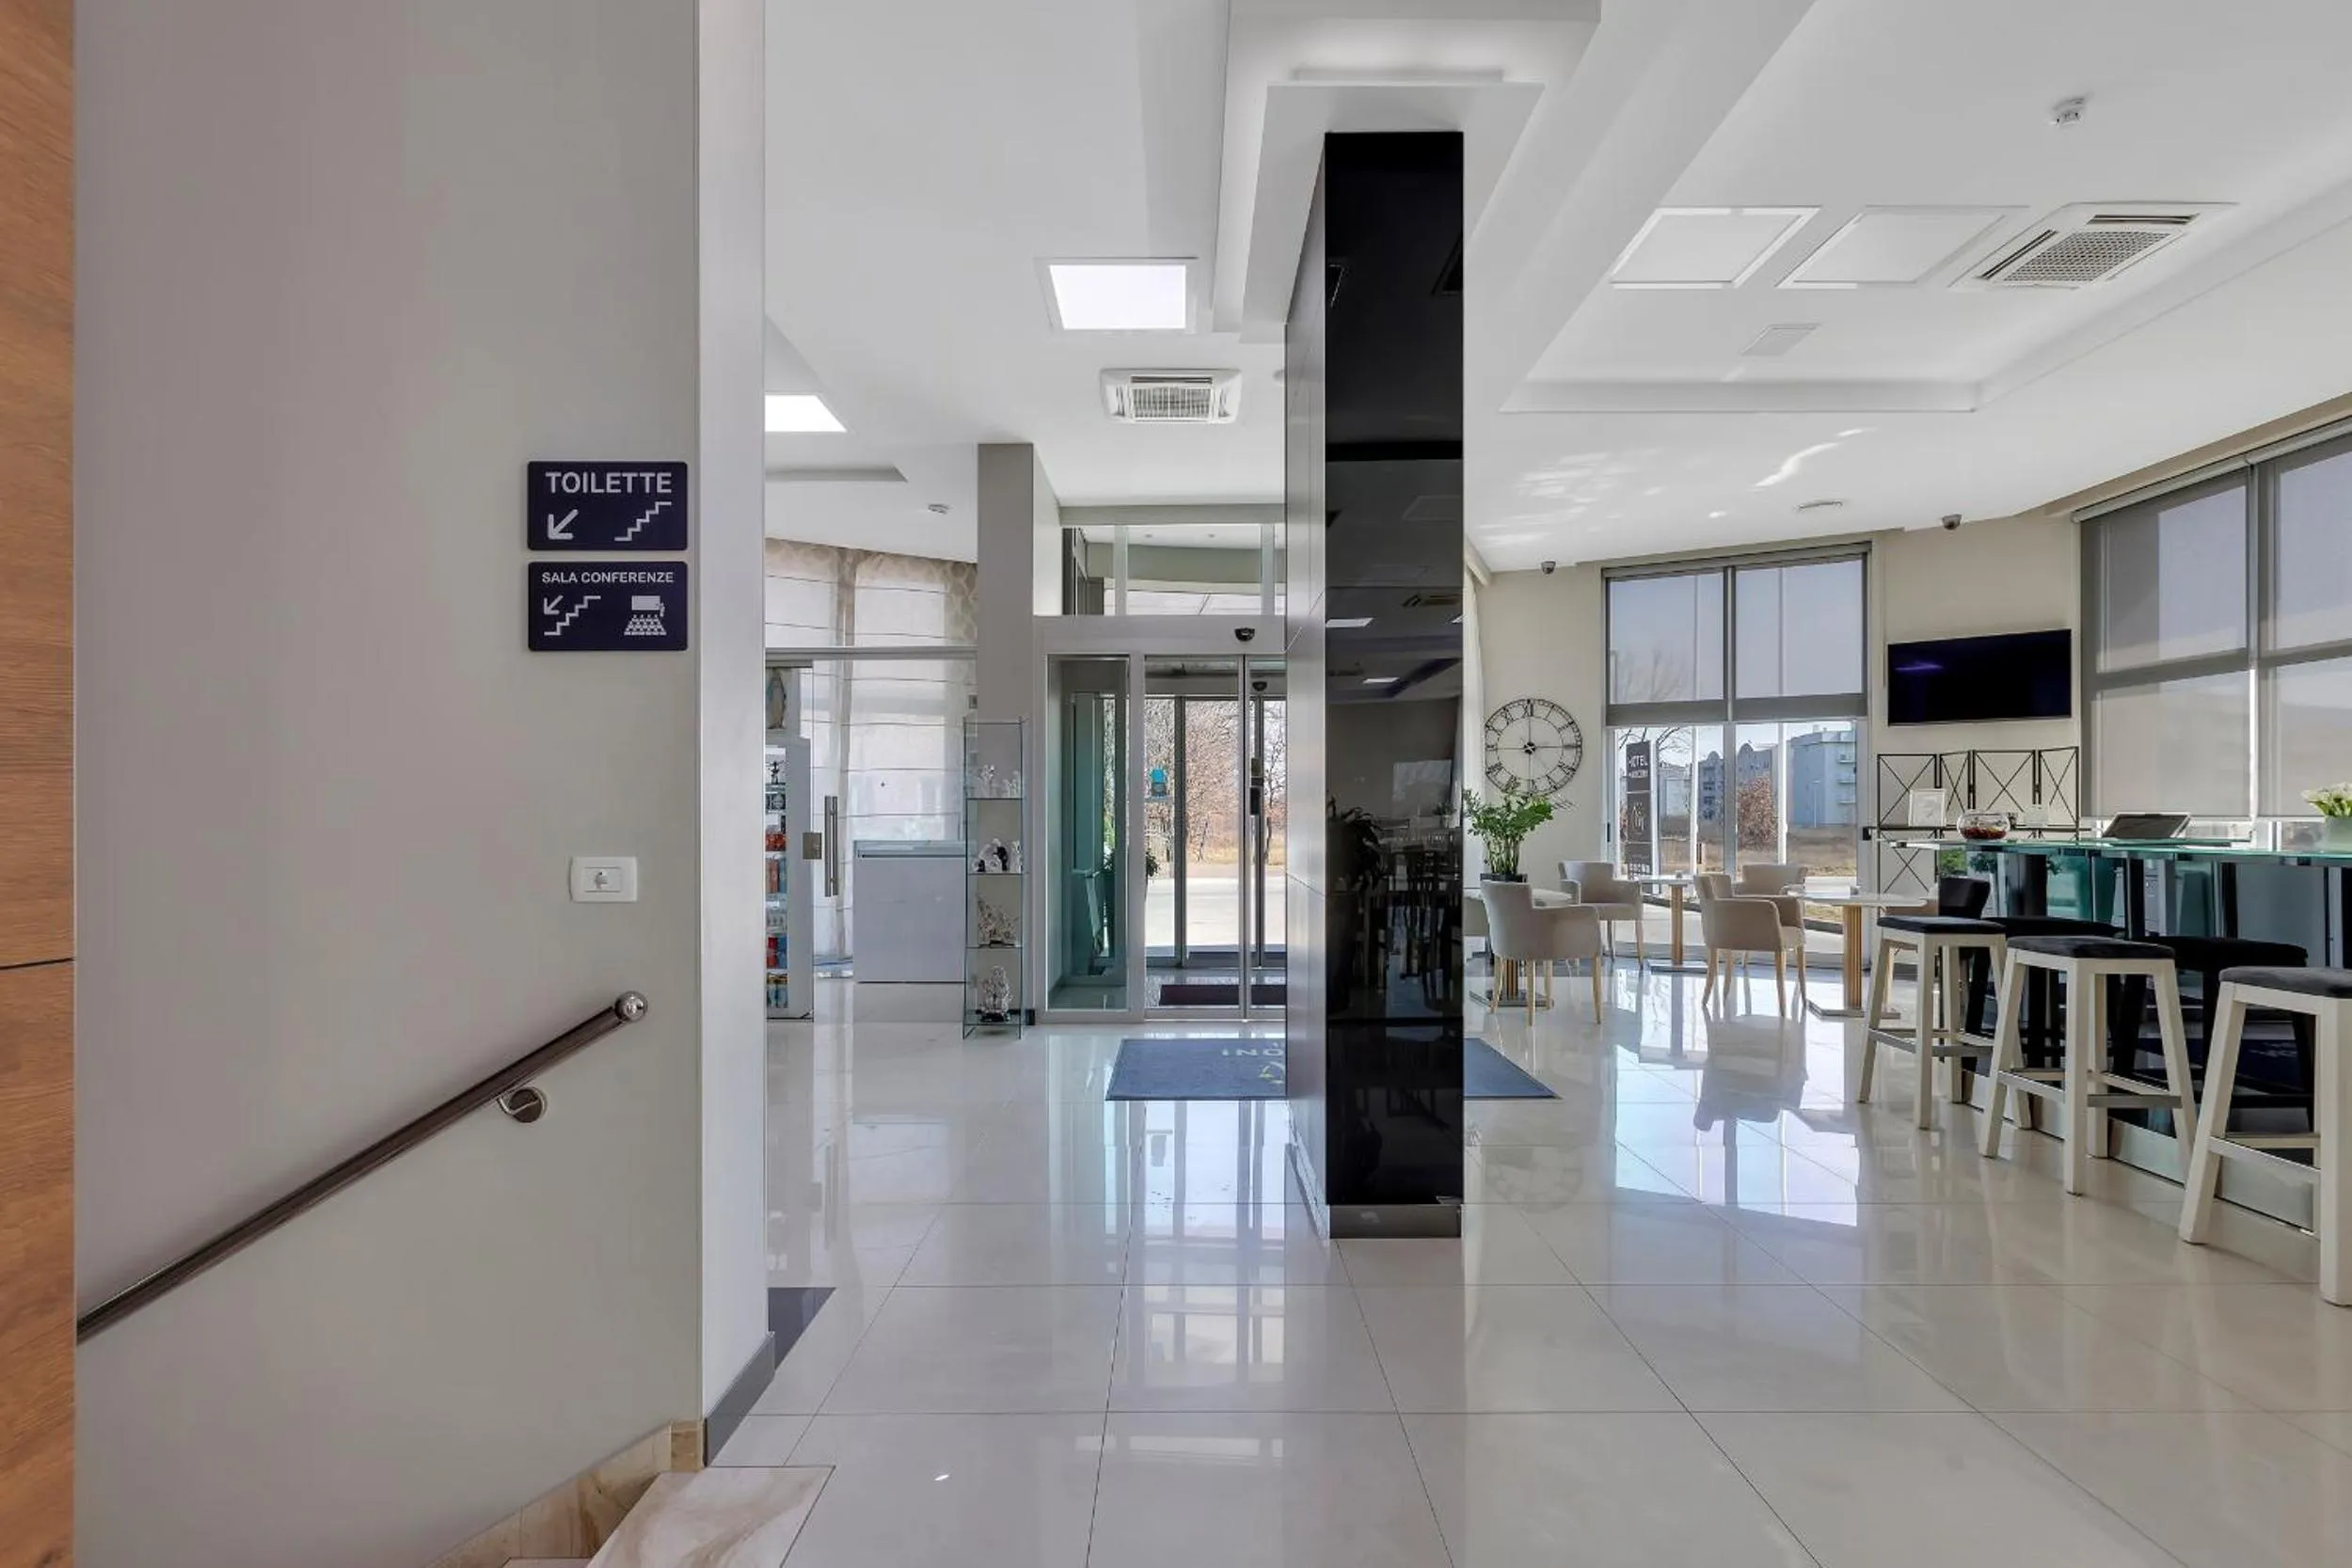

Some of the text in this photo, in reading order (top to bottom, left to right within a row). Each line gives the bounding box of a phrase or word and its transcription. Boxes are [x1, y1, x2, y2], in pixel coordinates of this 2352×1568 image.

[546, 471, 672, 494] TOILETTE
[542, 571, 675, 583] SALA CONFERENZE
